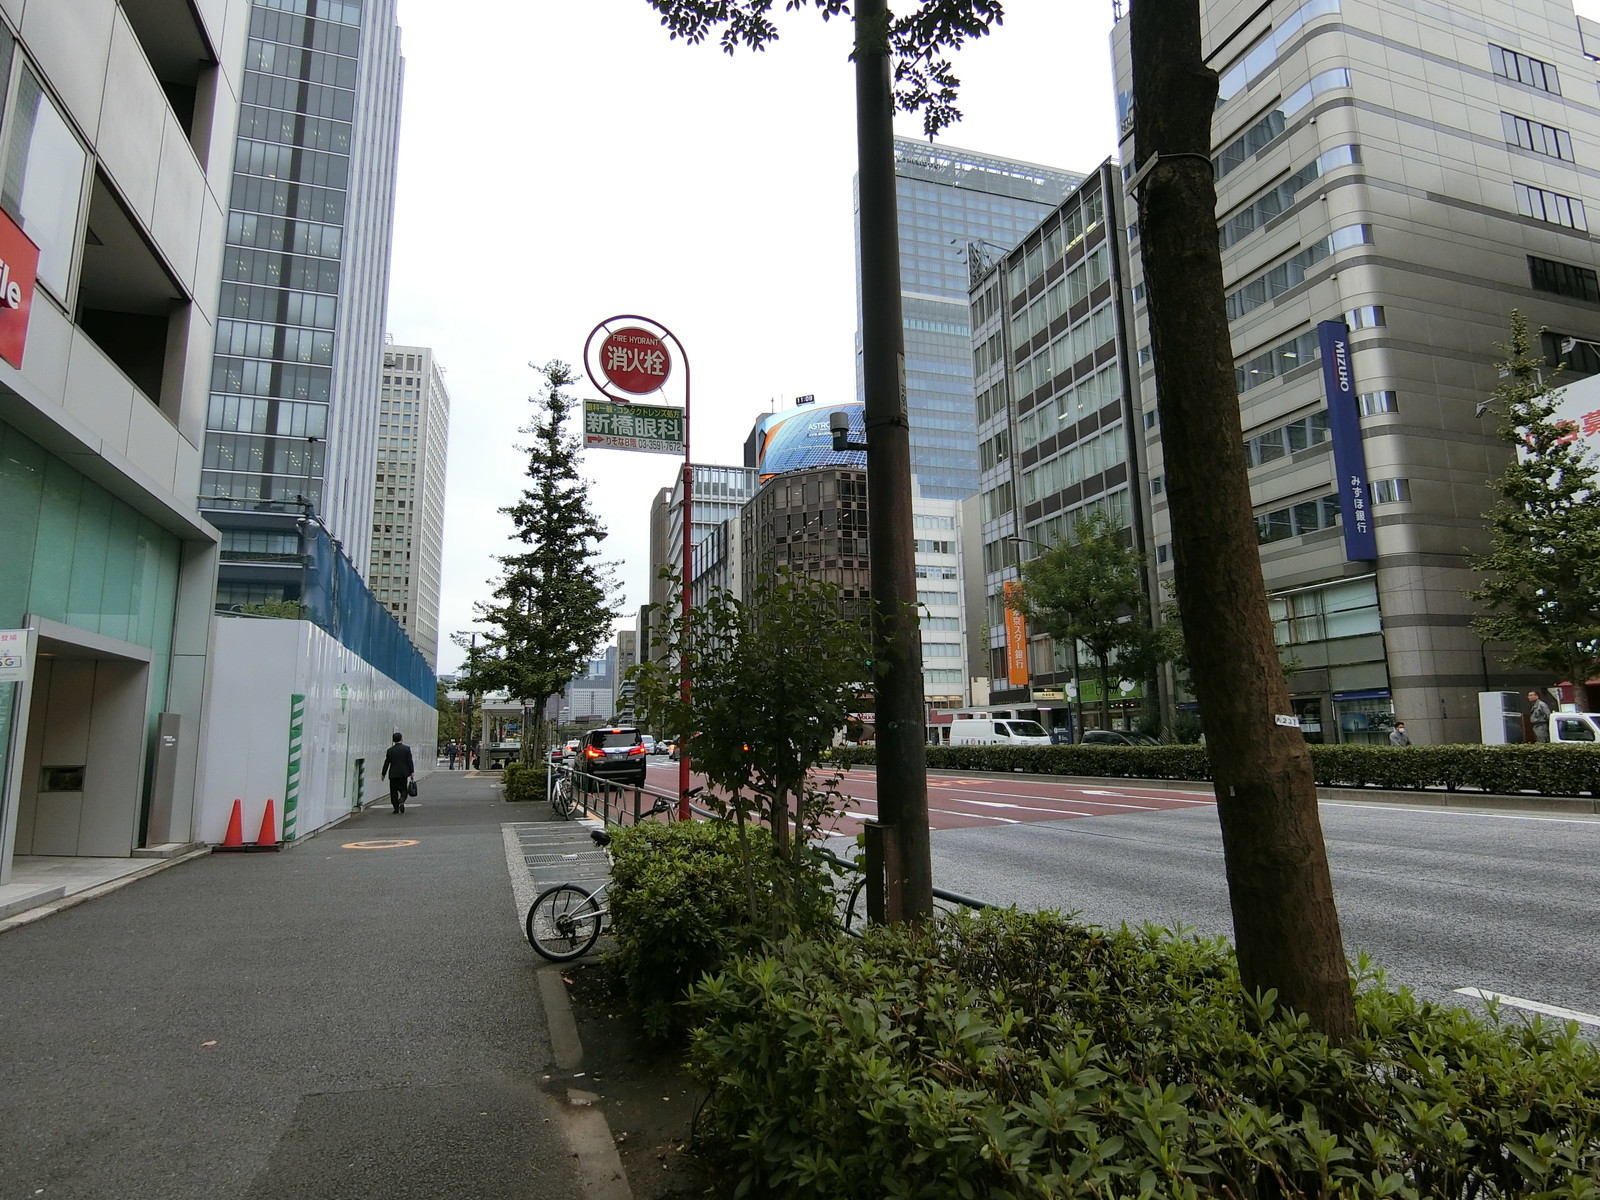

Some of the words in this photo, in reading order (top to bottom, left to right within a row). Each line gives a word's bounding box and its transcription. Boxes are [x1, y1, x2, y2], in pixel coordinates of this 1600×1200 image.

[612, 334, 627, 343] FIRE
[629, 336, 659, 346] HYDRANT
[607, 345, 666, 376] 消火栓
[1334, 340, 1349, 392] MIZUHO
[587, 412, 681, 440] 新橋眼科
[1351, 475, 1367, 533] みずほ銀行
